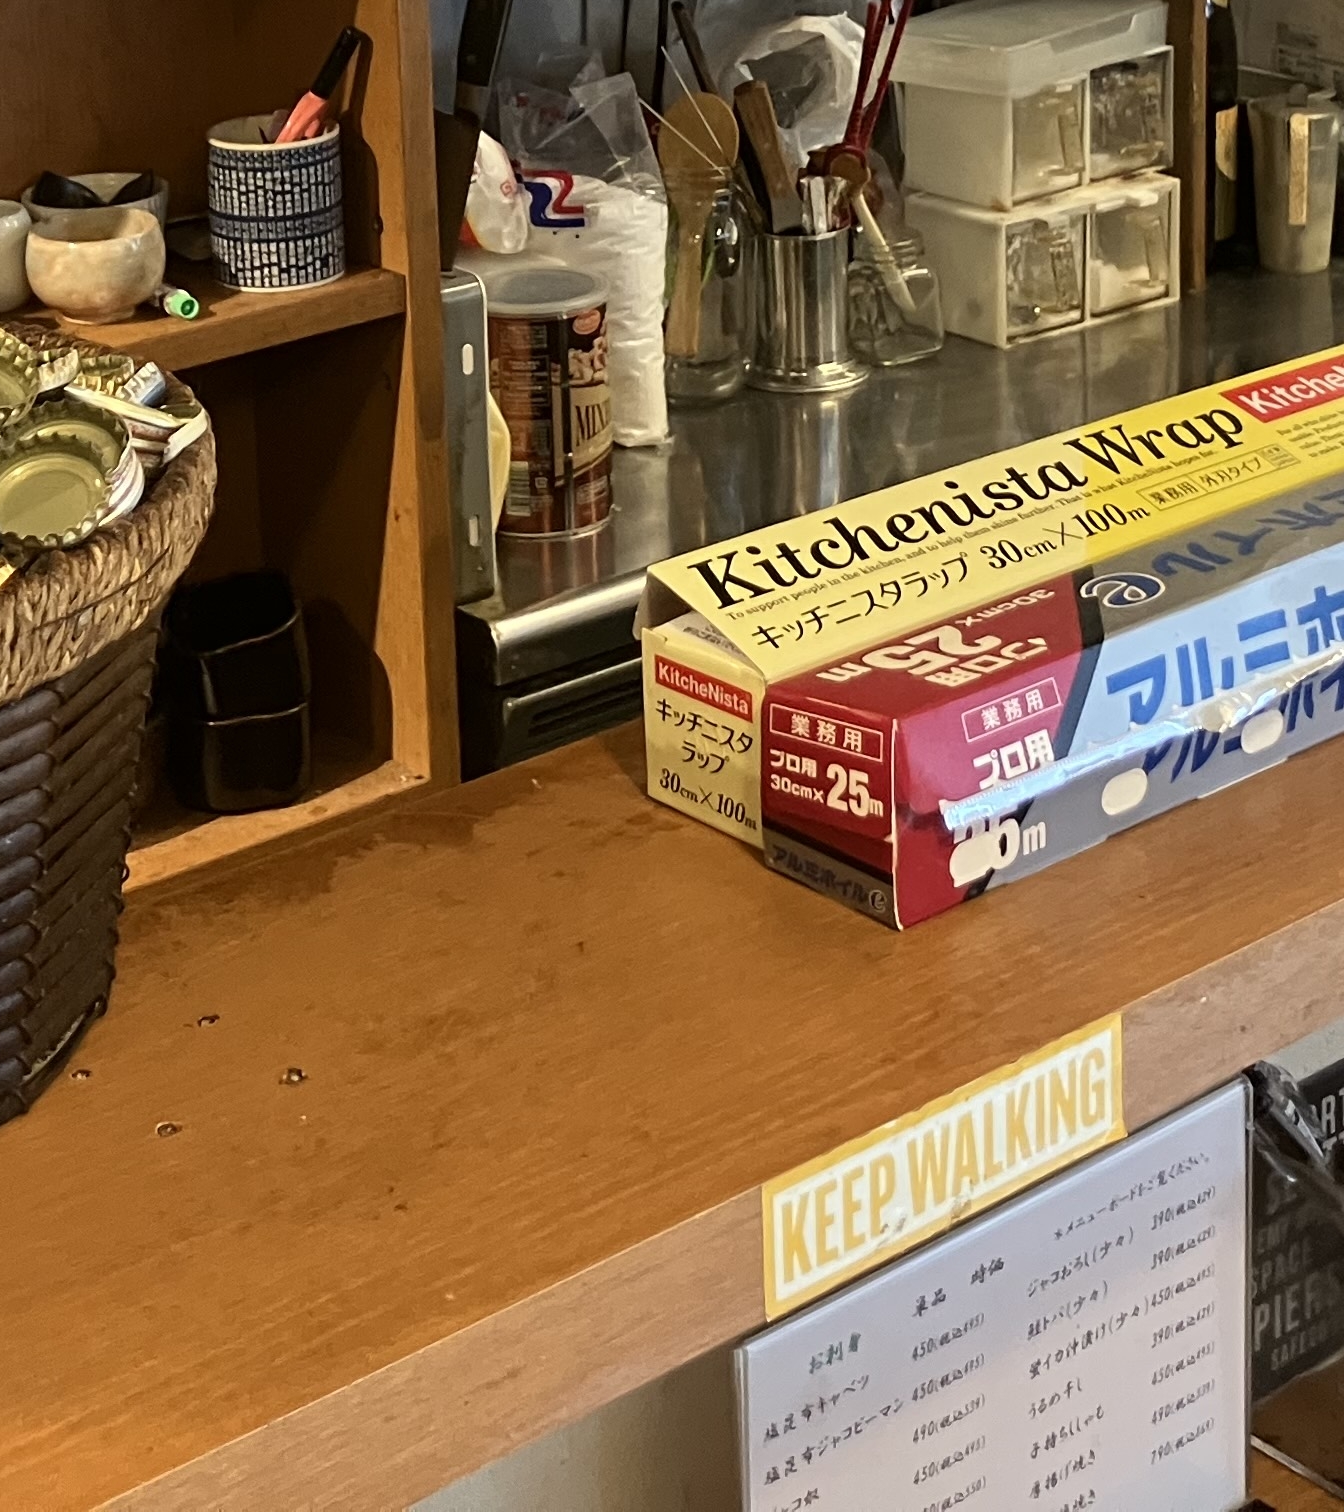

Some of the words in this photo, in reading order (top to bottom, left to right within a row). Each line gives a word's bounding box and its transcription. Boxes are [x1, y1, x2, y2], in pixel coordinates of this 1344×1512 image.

[1150, 480, 1199, 505] 業務用
[1199, 456, 1263, 489] 外刃タイプ
[688, 456, 1089, 610] Kitchenista
[1062, 407, 1244, 476] Wrap
[726, 610, 745, 621] To
[745, 595, 789, 615] support
[790, 582, 828, 602] people
[828, 577, 840, 586] in
[841, 570, 861, 582] the
[907, 547, 929, 559] and
[937, 536, 963, 548] help
[1056, 494, 1082, 507] That
[751, 551, 969, 649] キッチニスタラップ
[658, 661, 748, 715] KitcheNista
[924, 637, 1048, 687] プロ用
[656, 698, 753, 754] キッチニスタ
[791, 713, 862, 753] 業務用
[981, 688, 1044, 731] 業務用
[682, 740, 729, 774] ラップ
[770, 749, 817, 778] プロ用
[973, 729, 1054, 790] プロ用
[779, 1152, 897, 1283] KEEP
[906, 1045, 1108, 1207] WALKING
